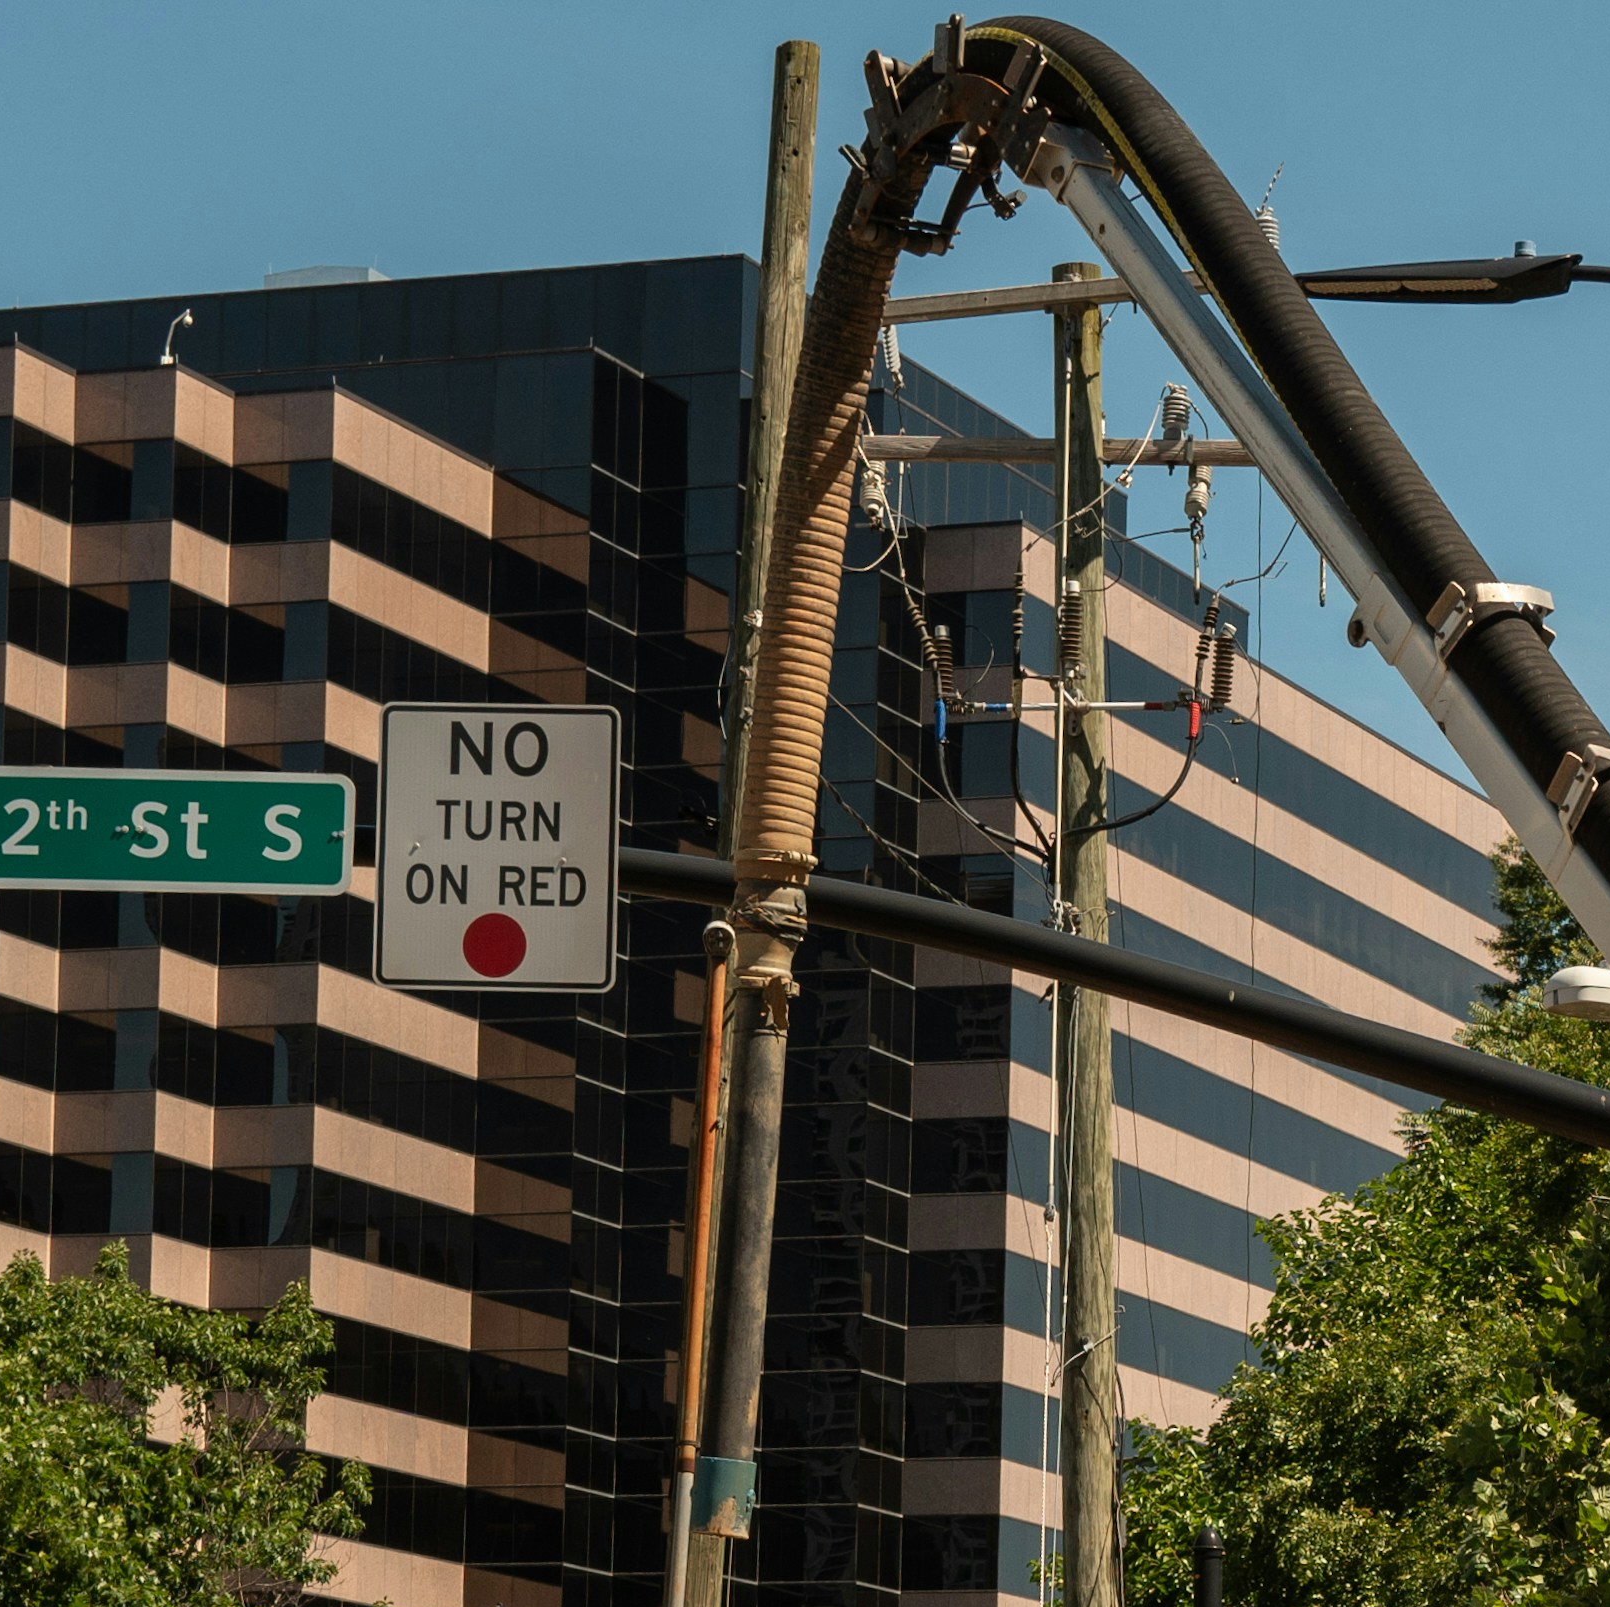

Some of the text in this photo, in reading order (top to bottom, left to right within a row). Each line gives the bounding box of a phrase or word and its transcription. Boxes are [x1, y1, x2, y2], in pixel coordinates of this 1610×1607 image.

[450, 720, 550, 778] NO
[129, 801, 209, 860] St
[261, 804, 303, 862] S
[436, 799, 562, 843] TURN
[405, 862, 587, 909] ON RED
